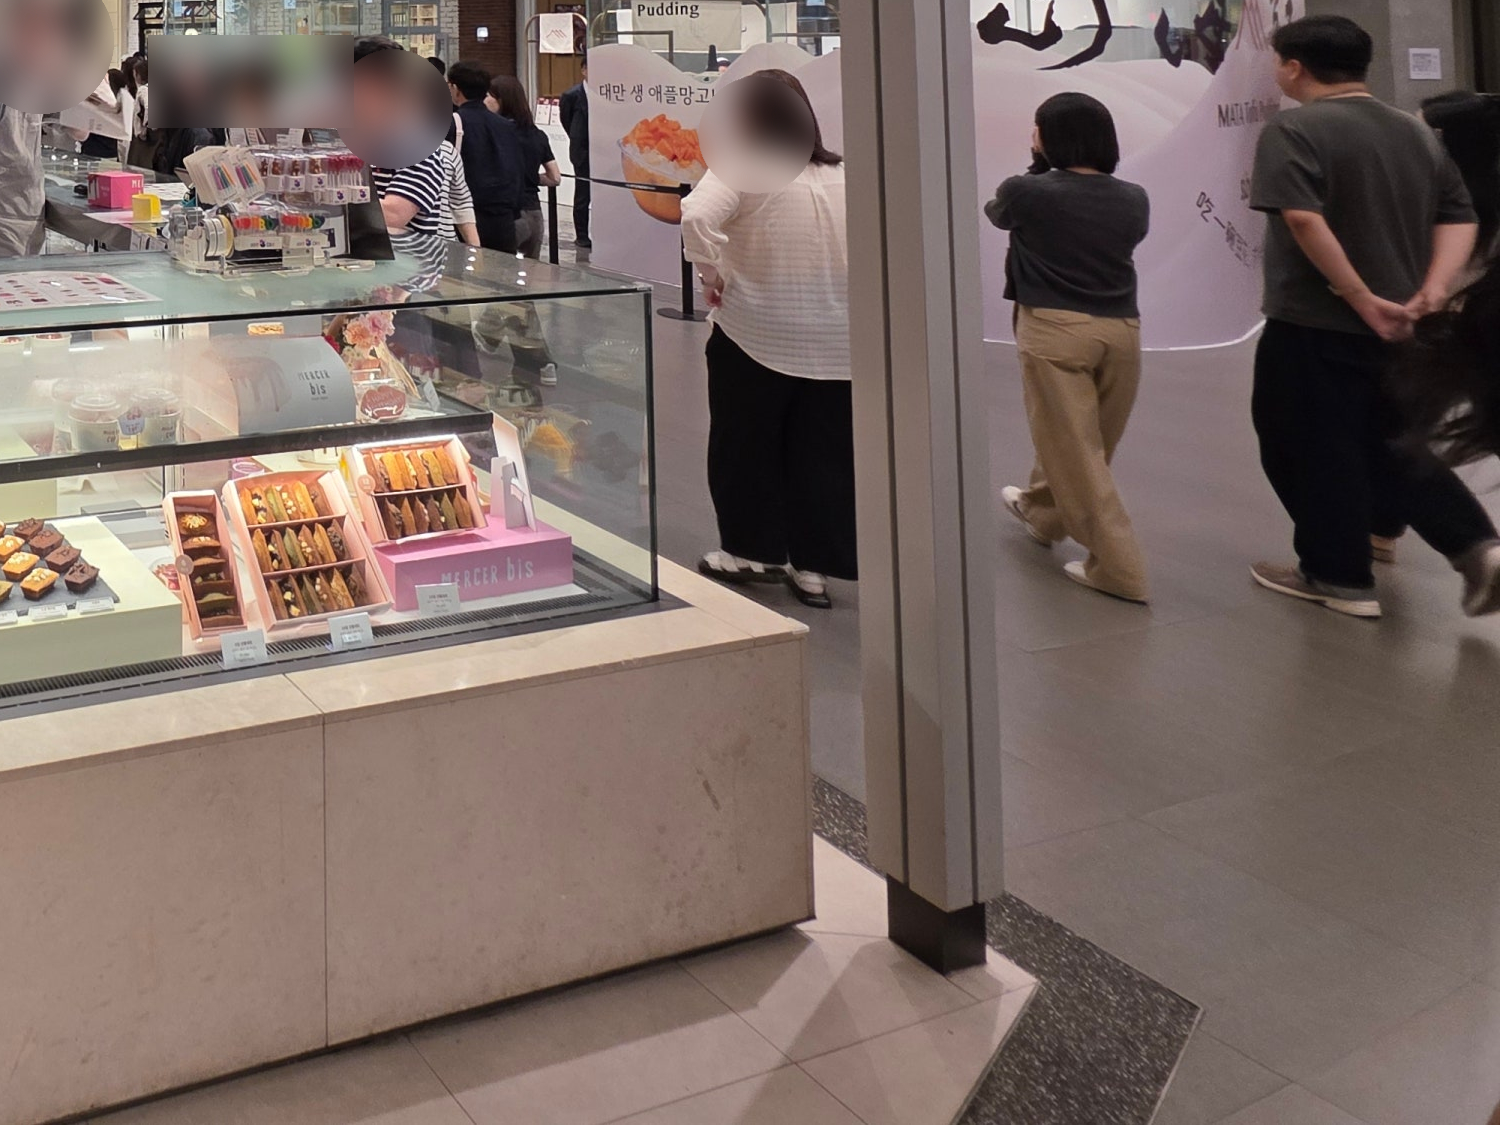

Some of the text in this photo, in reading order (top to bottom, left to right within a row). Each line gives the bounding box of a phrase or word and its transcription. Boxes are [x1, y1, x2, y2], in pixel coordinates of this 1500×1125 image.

[637, 1, 700, 19] Pudding
[599, 83, 715, 106] 대만 생 애플망고
[308, 382, 327, 396] bis
[505, 557, 534, 582] bis
